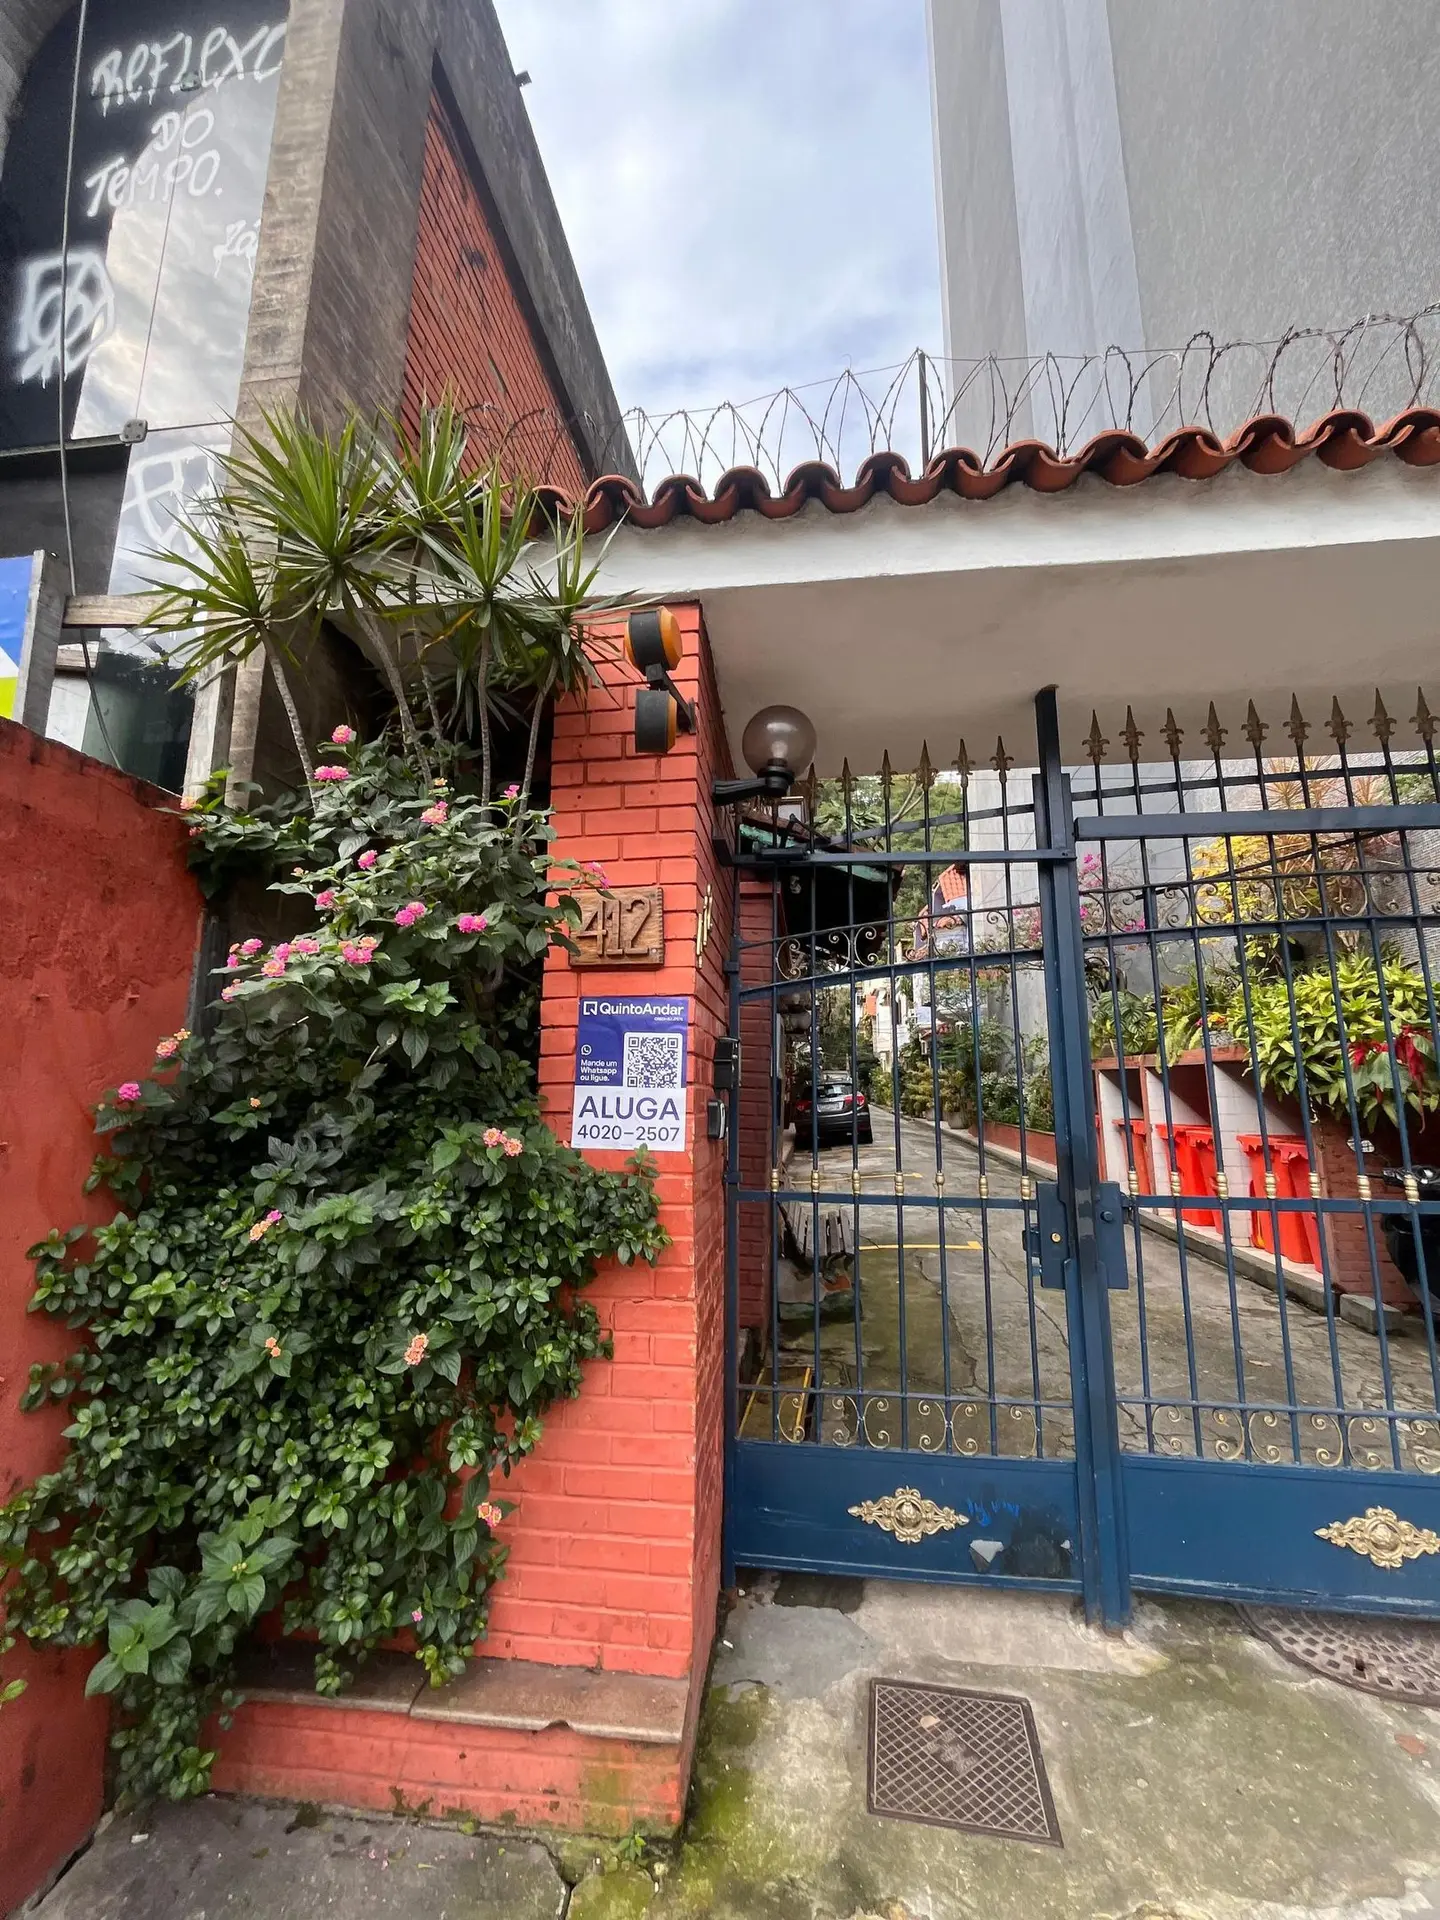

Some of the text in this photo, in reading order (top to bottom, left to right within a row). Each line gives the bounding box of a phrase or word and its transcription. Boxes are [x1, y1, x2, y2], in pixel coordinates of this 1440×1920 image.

[151, 108, 214, 151] DO
[576, 899, 651, 956] 412
[600, 1002, 684, 1016] QuintoAndar
[581, 1059, 605, 1067] Mande
[580, 1066, 617, 1076] Whatsapp
[591, 1074, 610, 1082] ligue.
[578, 1096, 680, 1121] ALUGA
